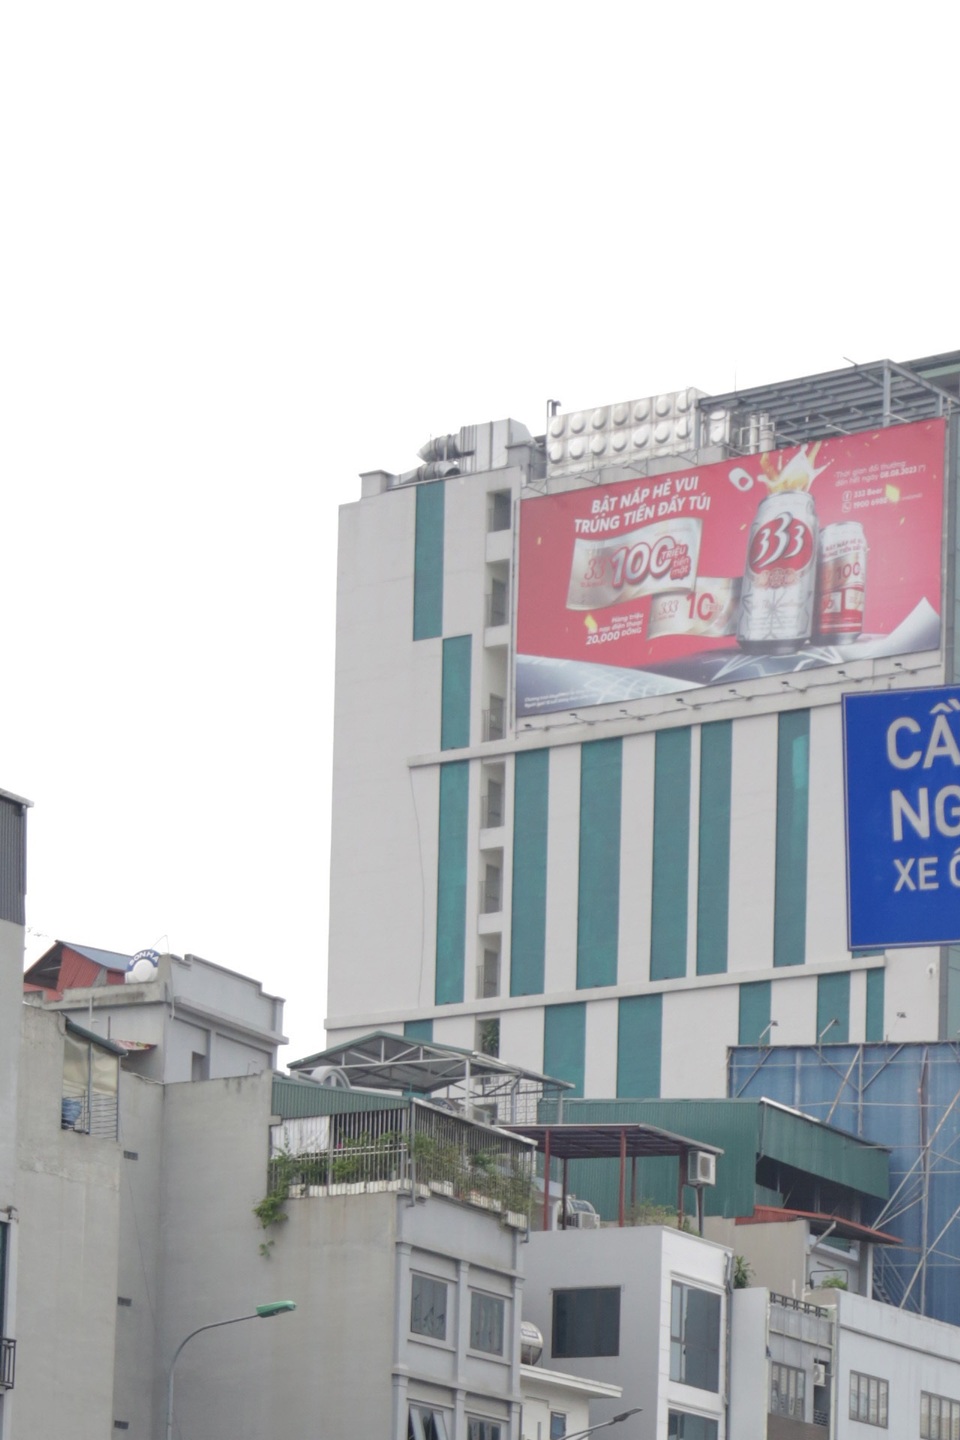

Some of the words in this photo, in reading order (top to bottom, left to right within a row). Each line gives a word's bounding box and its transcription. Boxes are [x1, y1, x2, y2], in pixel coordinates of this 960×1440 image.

[574, 515, 620, 533] TRÚNG
[624, 504, 655, 526] TIỀN
[657, 494, 685, 516] ĐẦY
[689, 493, 711, 511] TÚI
[591, 495, 618, 516] BẬT
[620, 487, 650, 509] NẮP
[652, 479, 672, 499] HÈ
[675, 476, 699, 491] VUI
[753, 512, 806, 568] 333
[612, 536, 676, 588] 100
[893, 856, 939, 892] XE
